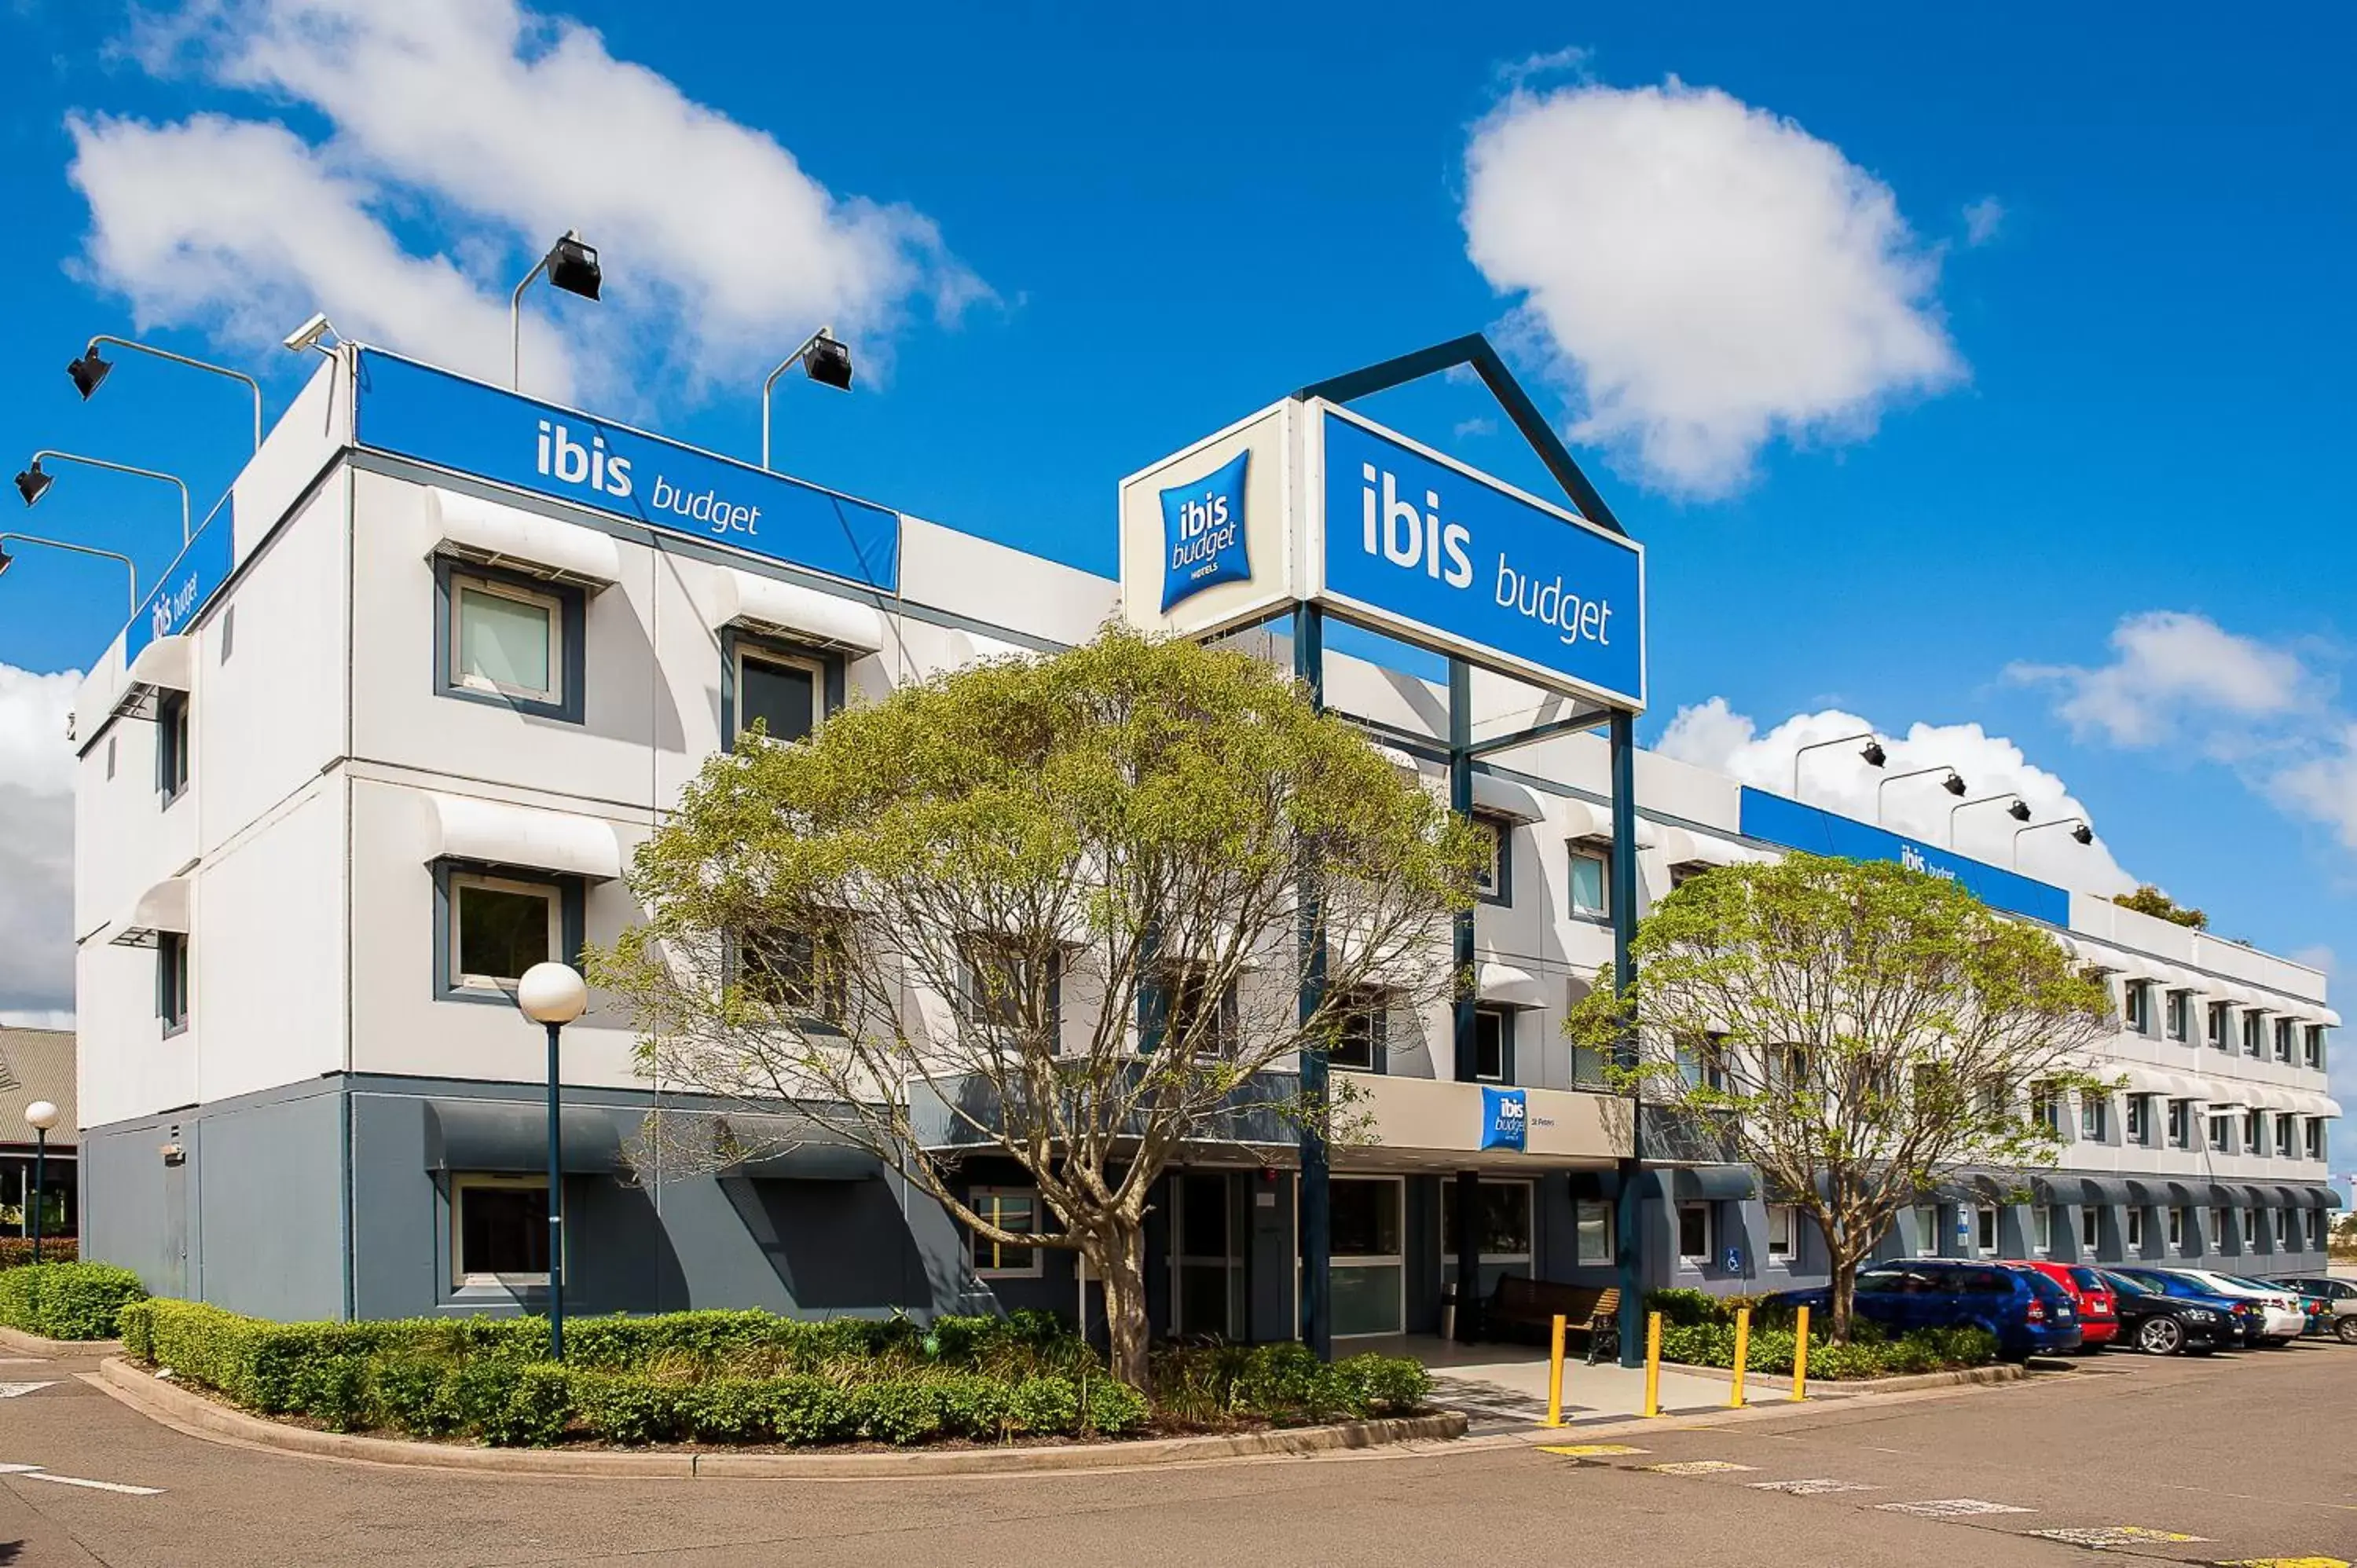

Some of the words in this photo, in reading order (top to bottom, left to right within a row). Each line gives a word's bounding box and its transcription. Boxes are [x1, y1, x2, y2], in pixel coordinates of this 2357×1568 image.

[538, 419, 633, 498] ibis
[653, 476, 761, 535] budget
[1180, 491, 1228, 541] ibis
[1172, 521, 1237, 570] budget
[1363, 463, 1473, 589] ibis
[1496, 552, 1612, 645] budget
[1190, 562, 1219, 580] HOTELS
[152, 592, 171, 641] ibis
[174, 570, 198, 622] budget
[1901, 844, 1926, 874] ibis
[1501, 1097, 1523, 1118] ibis
